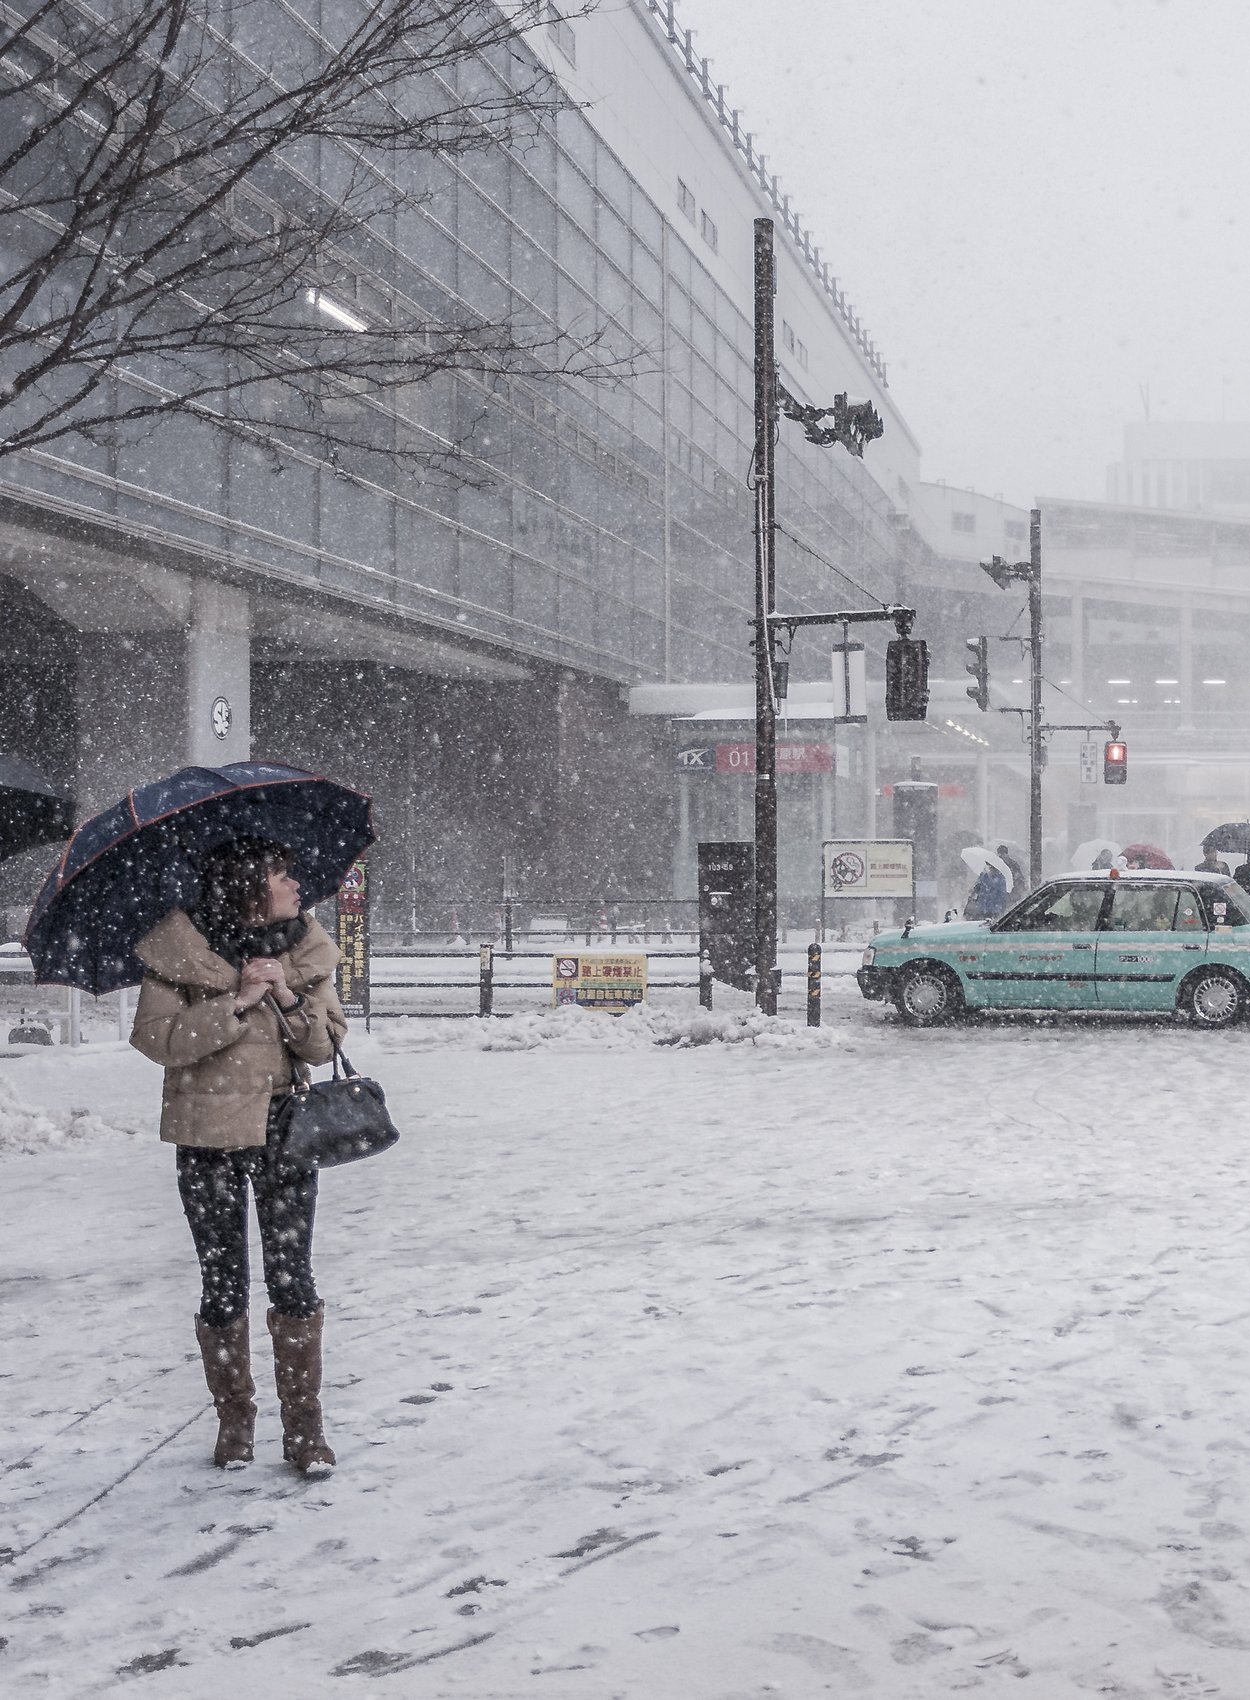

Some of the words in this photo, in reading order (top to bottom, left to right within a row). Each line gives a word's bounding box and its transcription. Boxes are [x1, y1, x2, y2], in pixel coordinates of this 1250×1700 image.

[677, 748, 710, 766] TX
[582, 965, 643, 978] 路上喫煙禁止
